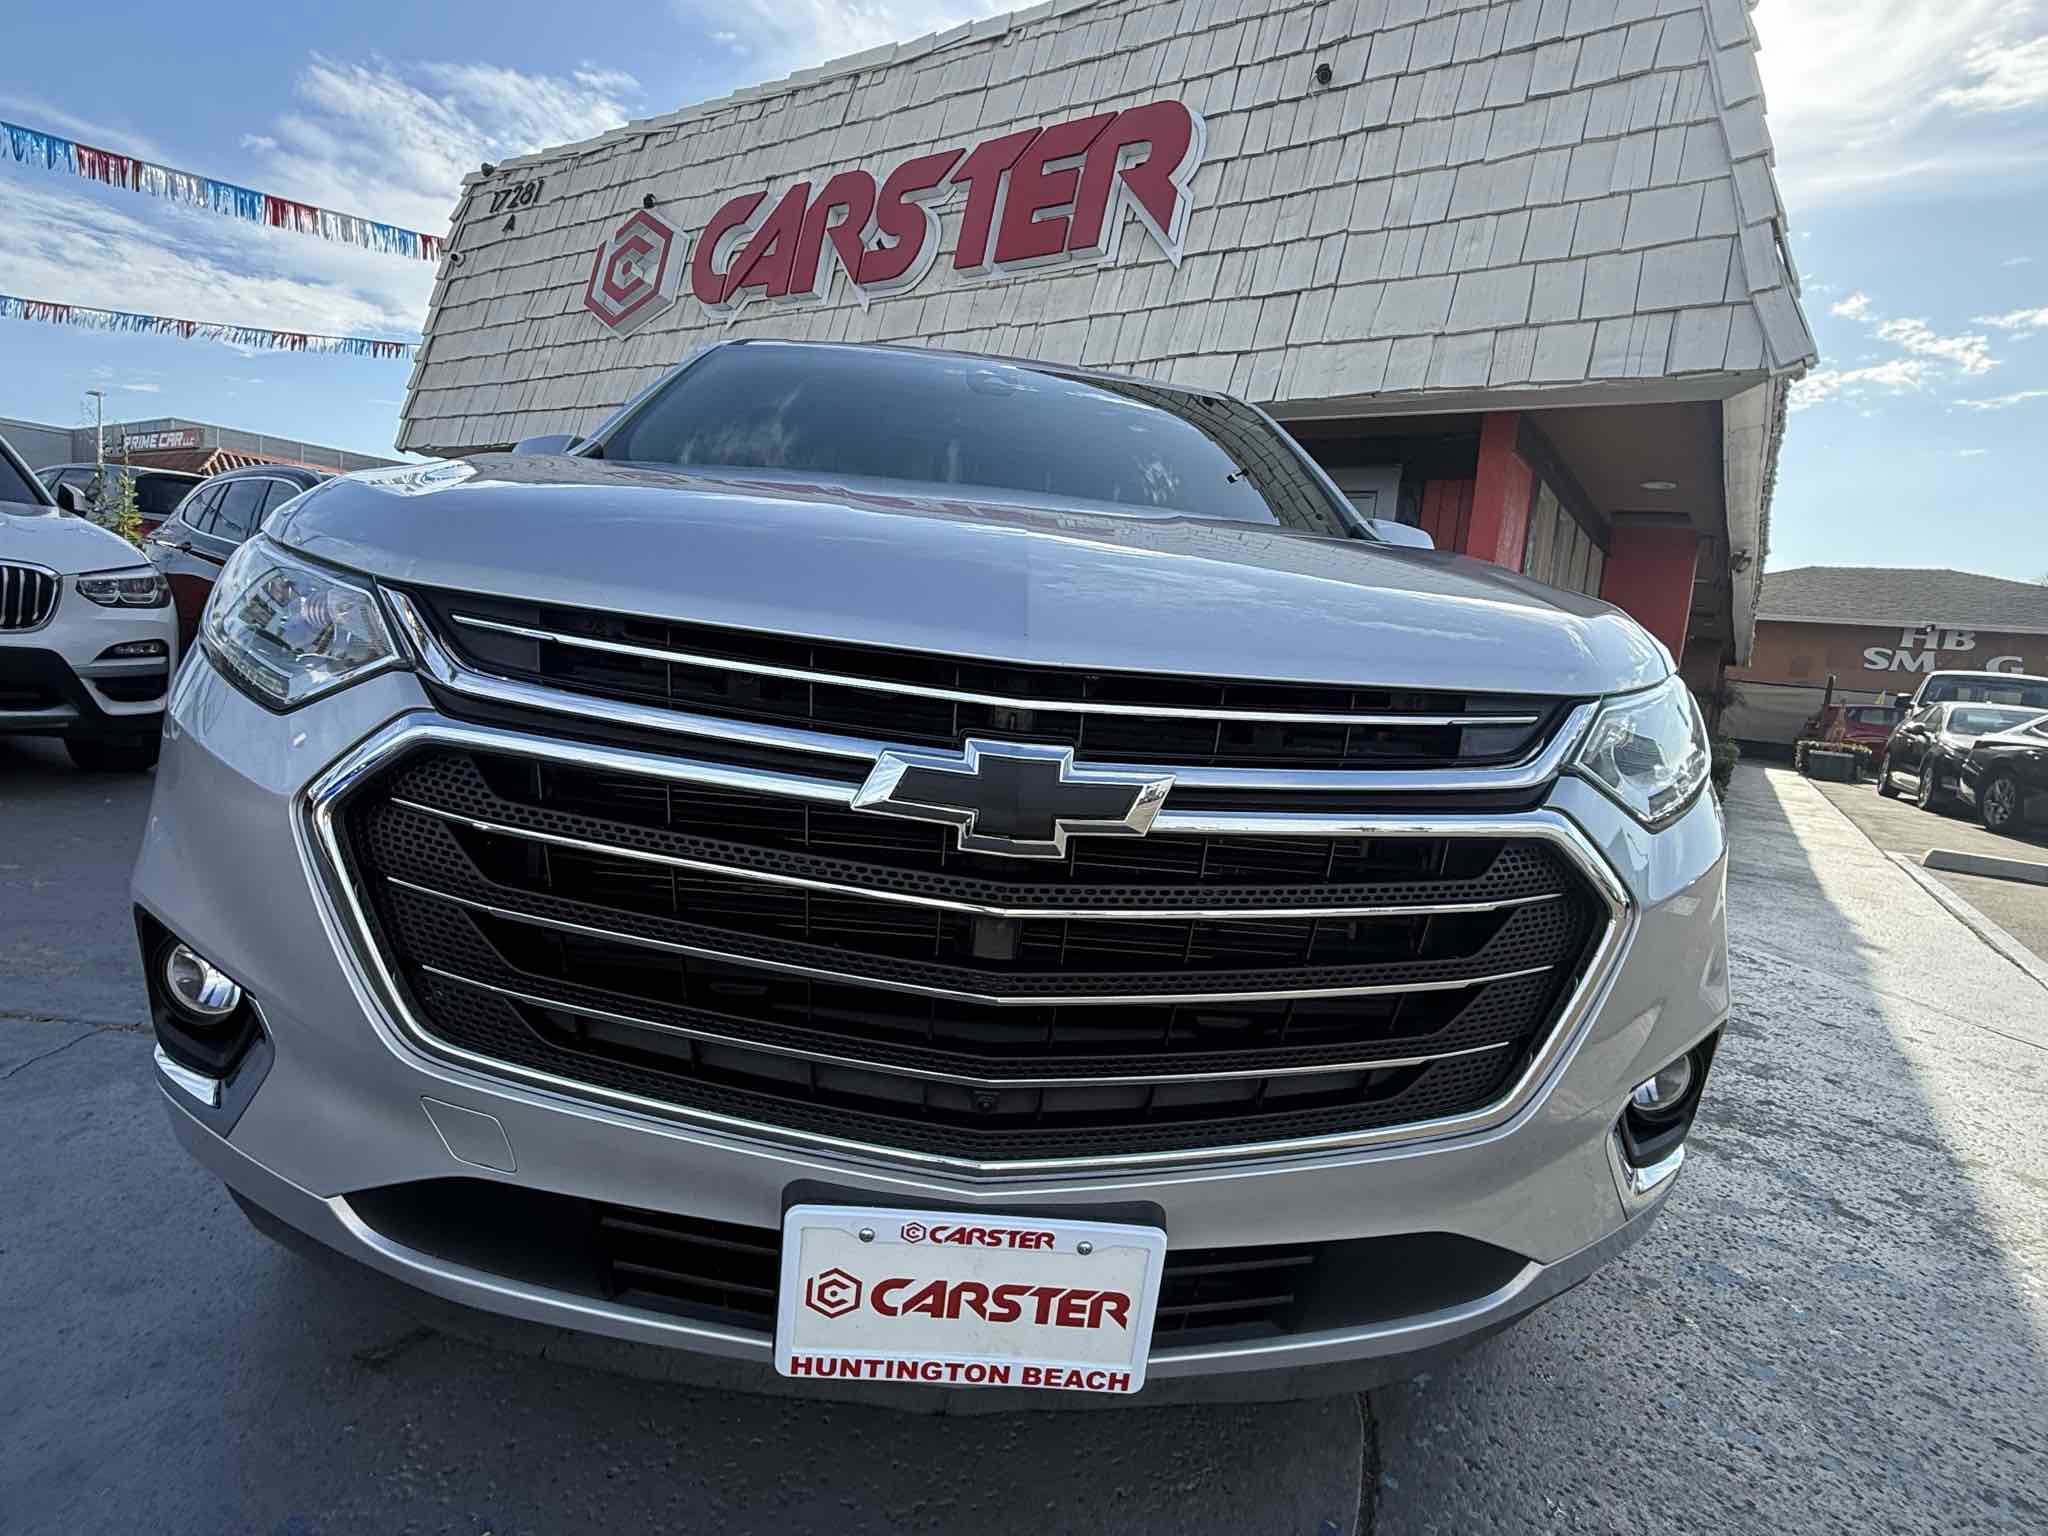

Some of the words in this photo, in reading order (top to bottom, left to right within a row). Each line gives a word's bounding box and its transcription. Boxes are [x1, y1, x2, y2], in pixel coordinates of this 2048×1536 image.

[489, 178, 544, 213] 17281
[691, 99, 1200, 314] CARSTER
[502, 214, 516, 232] A
[123, 432, 159, 450] PRIME
[158, 431, 184, 448] CAR
[1900, 627, 1976, 650] HB
[929, 1225, 1055, 1250] CARSTER
[870, 1277, 1132, 1331] CARSTER
[790, 1356, 1010, 1385] HUNTINGTON
[1021, 1367, 1131, 1392] BEACH
